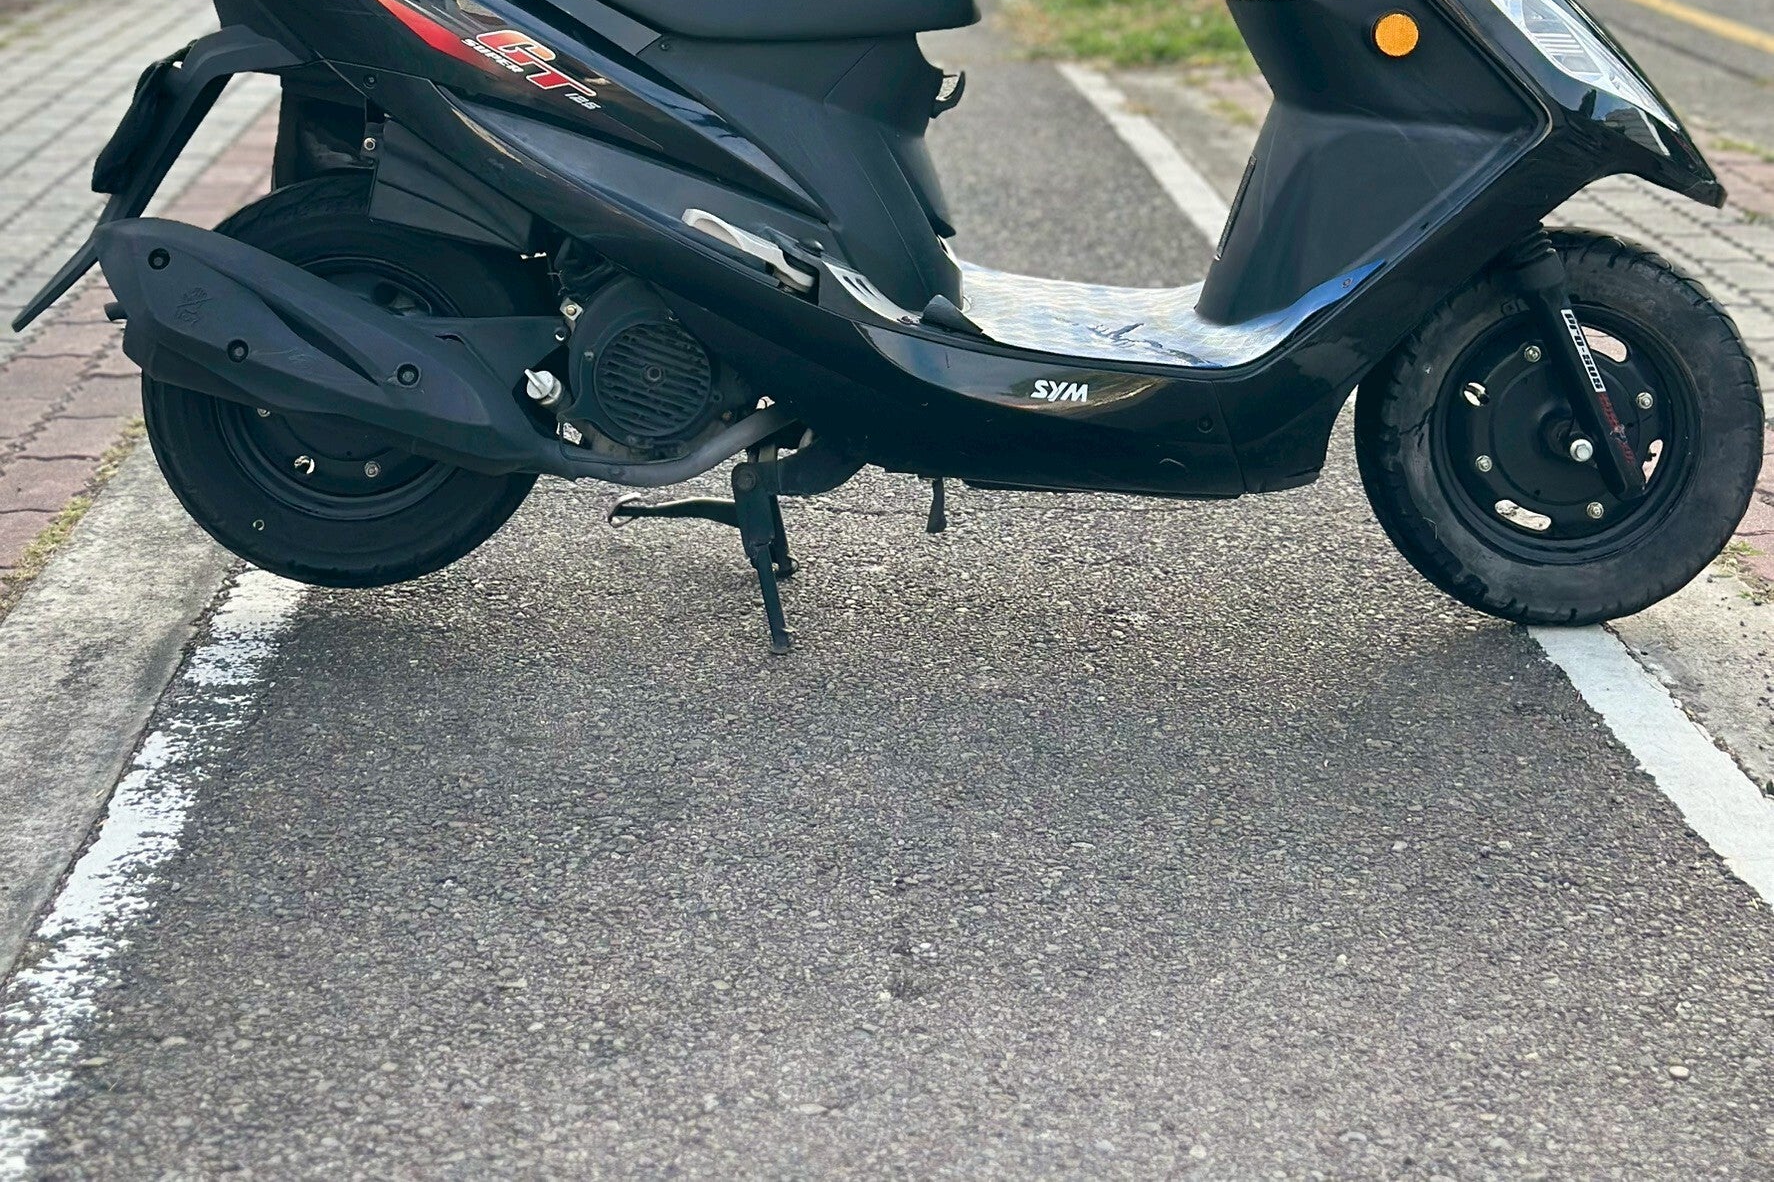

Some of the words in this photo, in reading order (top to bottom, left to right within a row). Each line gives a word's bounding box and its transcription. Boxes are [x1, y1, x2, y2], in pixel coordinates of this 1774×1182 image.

[461, 38, 524, 73] SUPER
[476, 29, 597, 97] GT
[564, 92, 602, 110] 125
[1030, 379, 1089, 403] SYM
